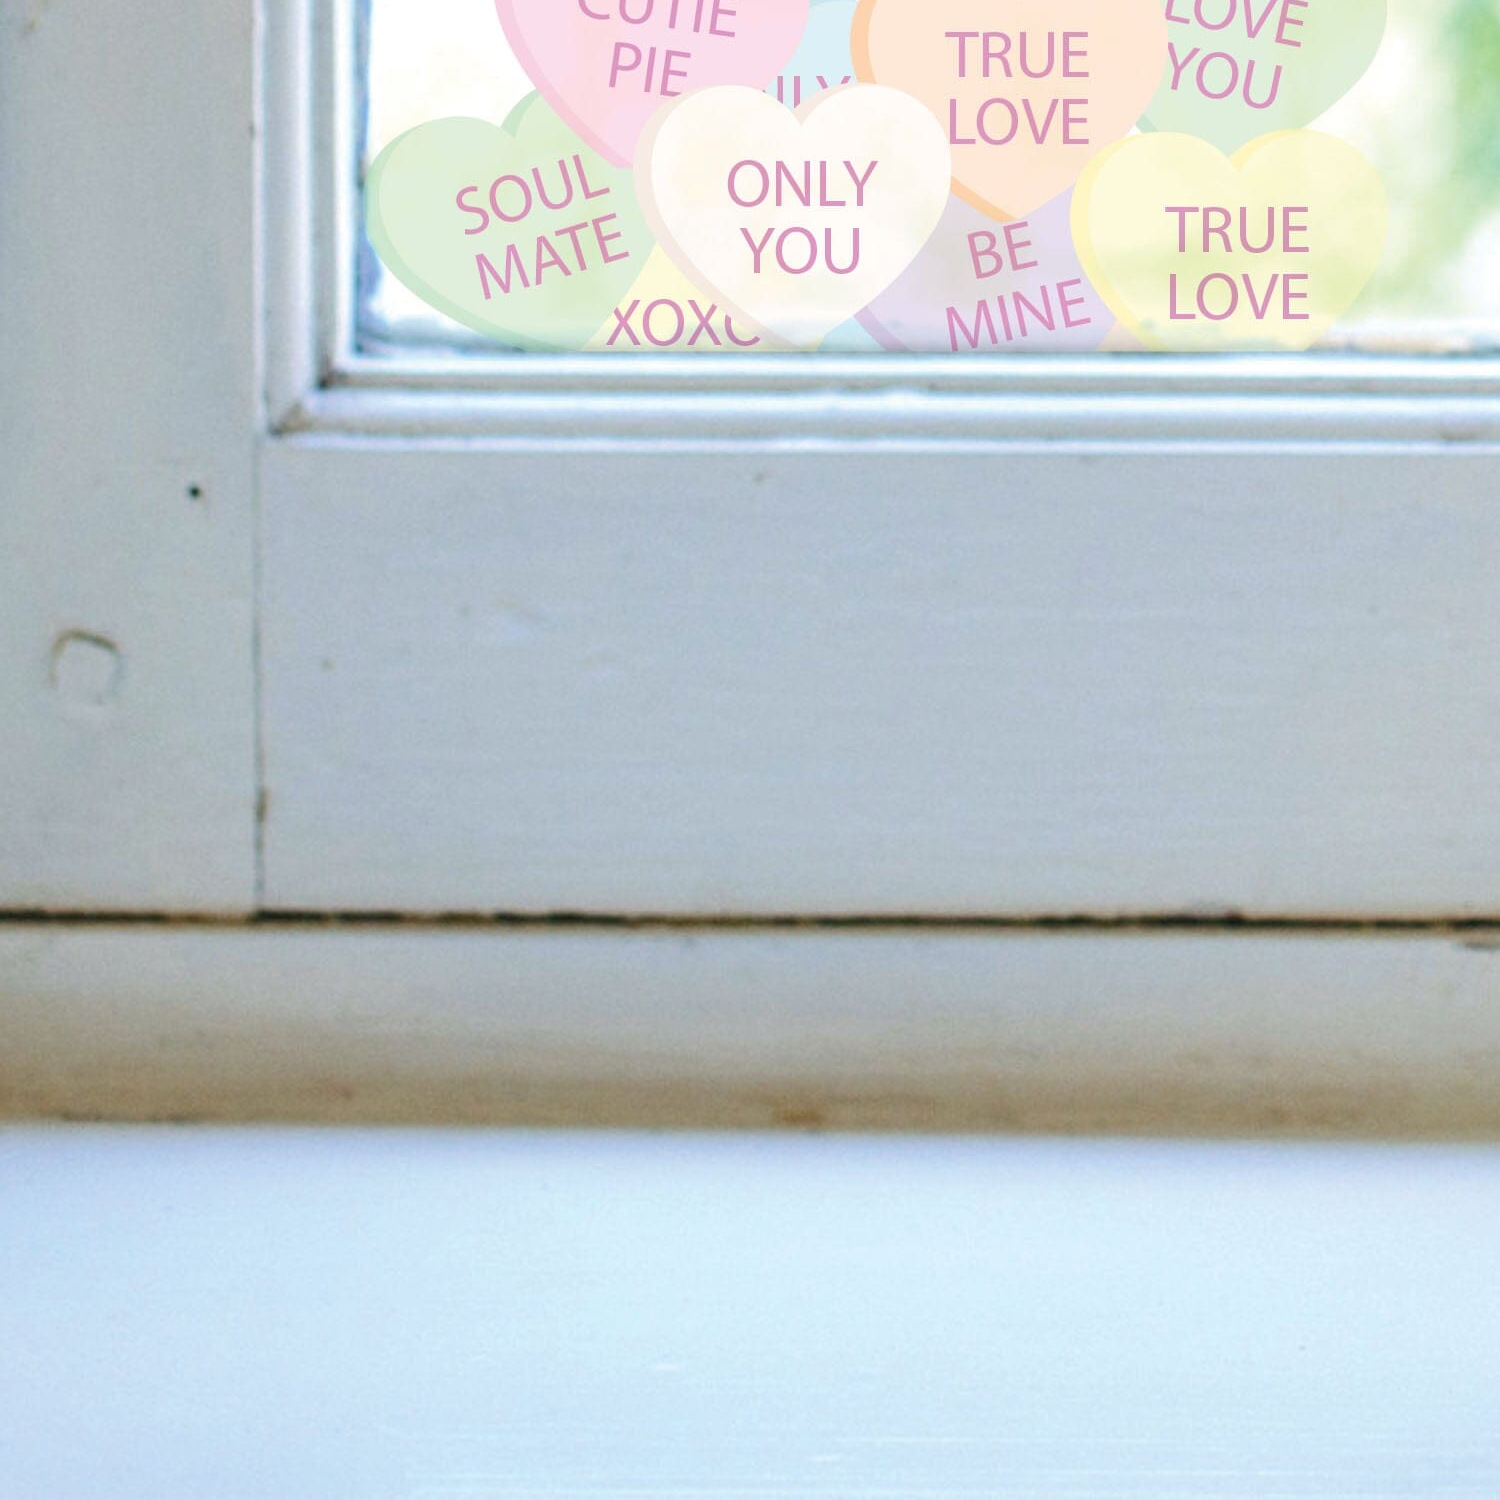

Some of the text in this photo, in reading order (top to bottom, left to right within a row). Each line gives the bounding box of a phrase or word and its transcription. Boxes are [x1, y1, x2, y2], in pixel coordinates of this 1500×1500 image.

[608, 41, 692, 97] PIE
[945, 31, 1089, 78] TRUE
[1167, 42, 1282, 109] YOU
[949, 98, 1089, 146] LOVE
[456, 153, 611, 236] SOUL
[727, 159, 878, 208] ONLY
[740, 227, 861, 275] YOU
[967, 220, 1039, 279] BE
[1165, 206, 1309, 253] TRUE
[475, 212, 630, 300] MATE
[946, 278, 1092, 352] MINE
[1169, 272, 1310, 321] LOVE
